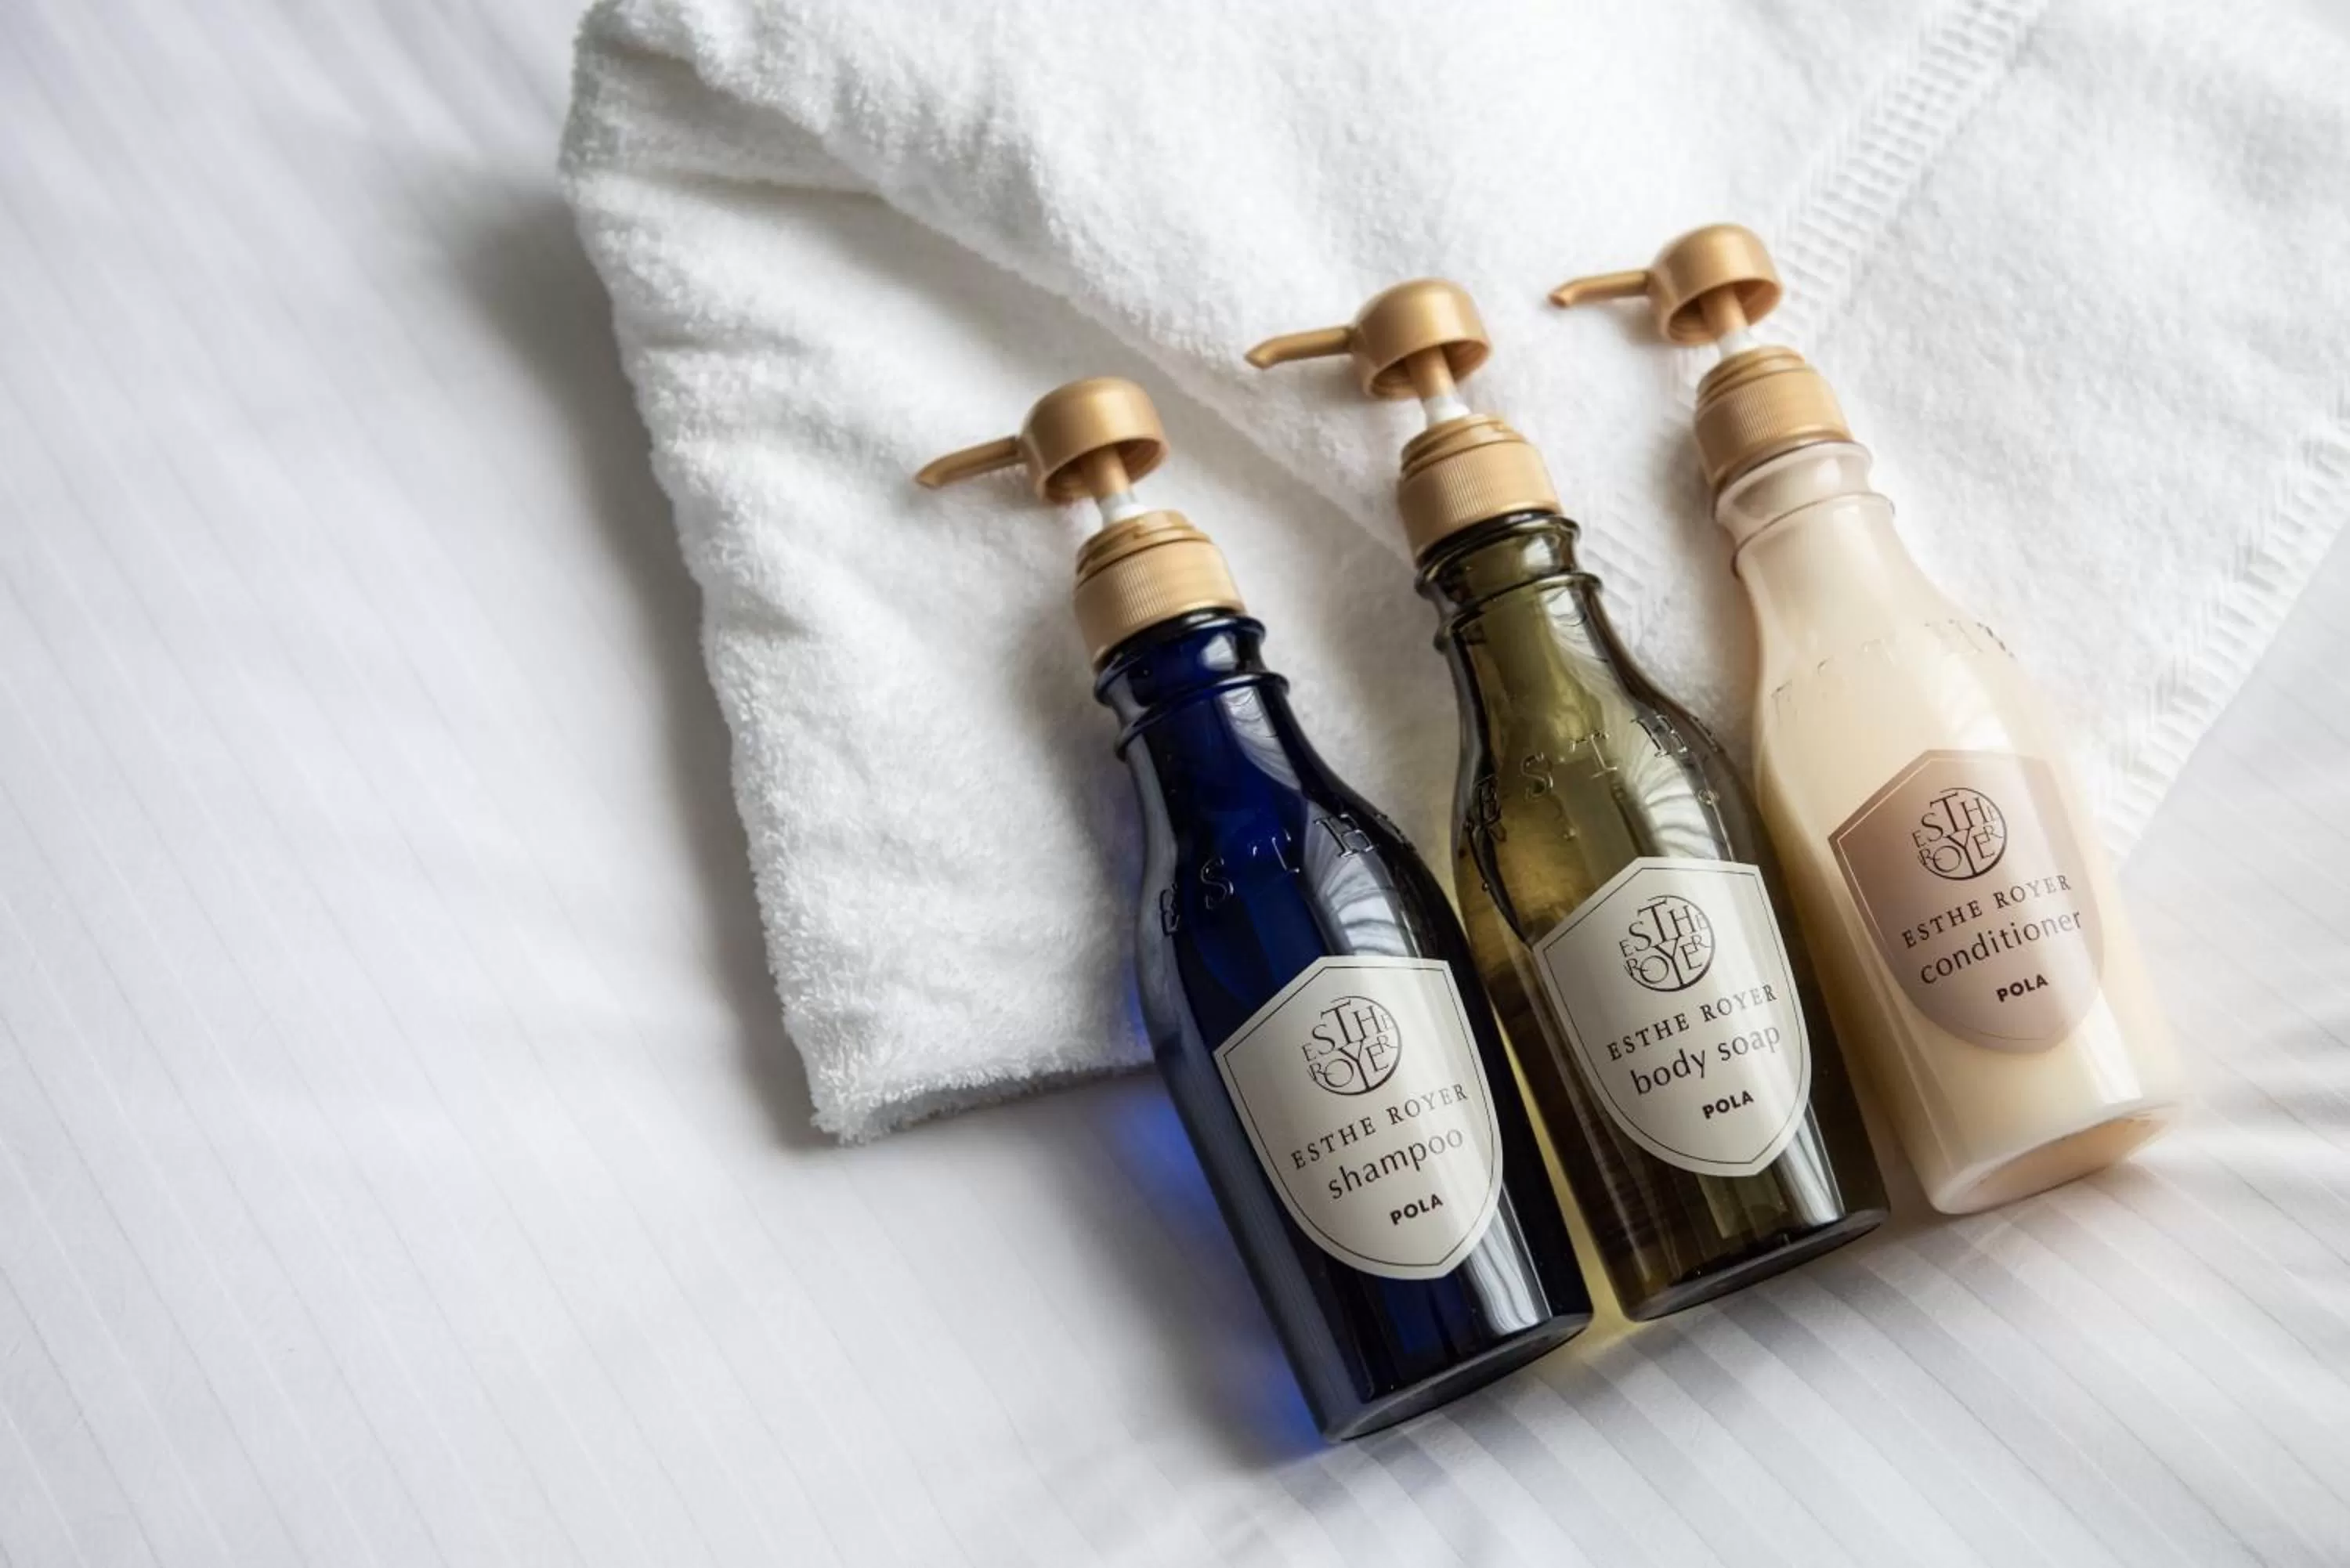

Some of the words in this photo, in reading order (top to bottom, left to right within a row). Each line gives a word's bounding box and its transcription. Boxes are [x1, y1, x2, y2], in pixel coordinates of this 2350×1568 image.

[1901, 900, 1983, 949] ESTHE
[1993, 874, 2072, 909] ROYER
[1920, 910, 2081, 985] conditioner
[1607, 1013, 1690, 1061] ESTHE
[1699, 984, 1777, 1023] ROYER
[1996, 974, 2049, 1003] POLA
[1629, 1048, 1706, 1095] body
[1717, 1026, 1781, 1062] soap
[1290, 1117, 1376, 1170] ESTHE
[1385, 1083, 1468, 1125] ROYER
[1701, 1089, 1755, 1119] POLA
[1328, 1129, 1463, 1200] shampoo
[1389, 1193, 1444, 1225] POLA
